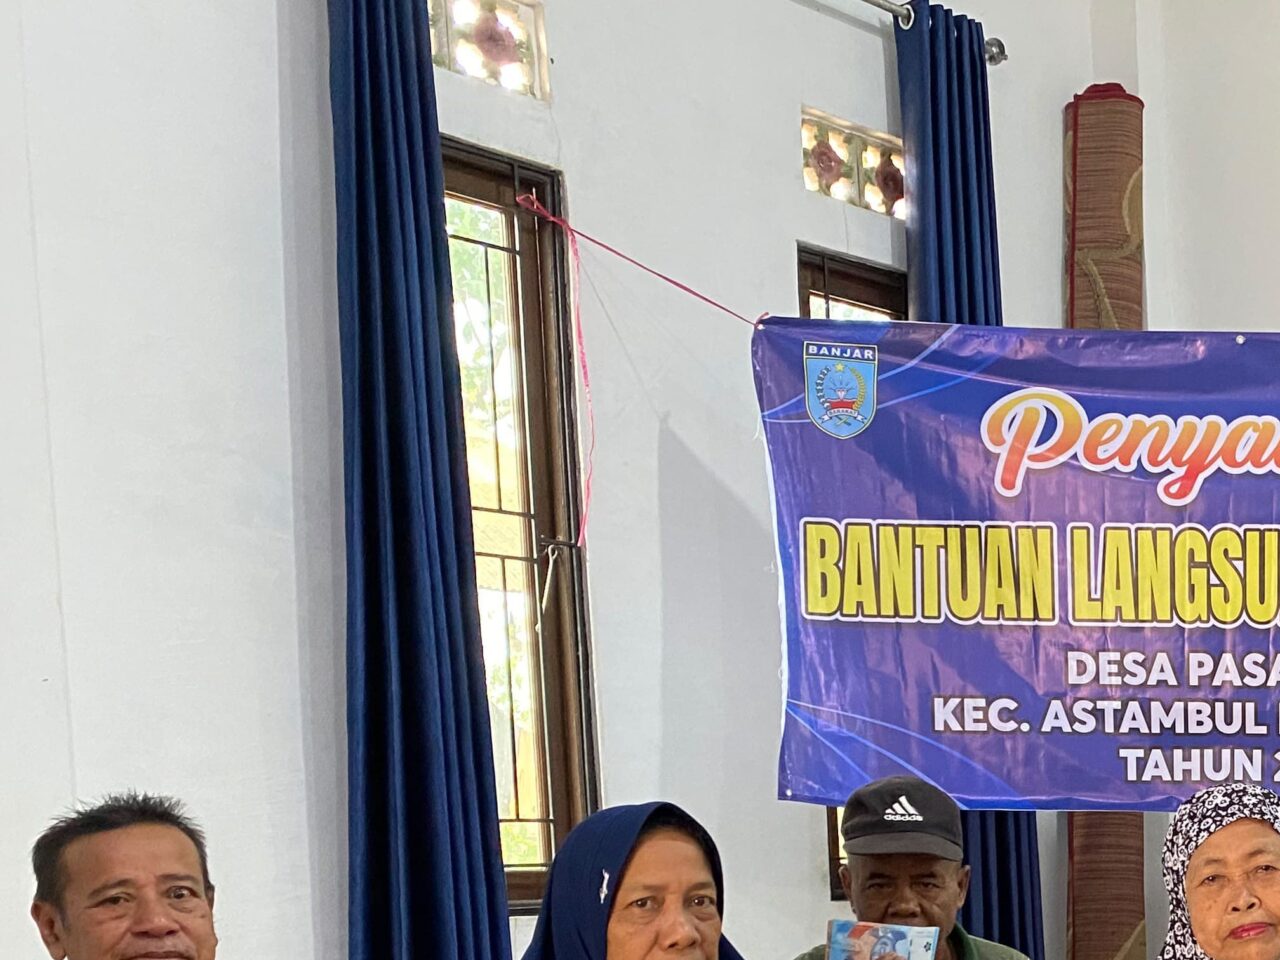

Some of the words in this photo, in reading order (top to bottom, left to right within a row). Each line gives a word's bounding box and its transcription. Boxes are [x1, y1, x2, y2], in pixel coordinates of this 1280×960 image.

[808, 345, 874, 359] BANJAR
[802, 520, 1056, 623] BANTUAN
[1068, 651, 1178, 686] DESA
[934, 697, 1030, 732] KEC.
[1041, 700, 1267, 735] ASTAMBUL
[1119, 748, 1262, 781] TAHUN
[883, 813, 924, 822] adidas
